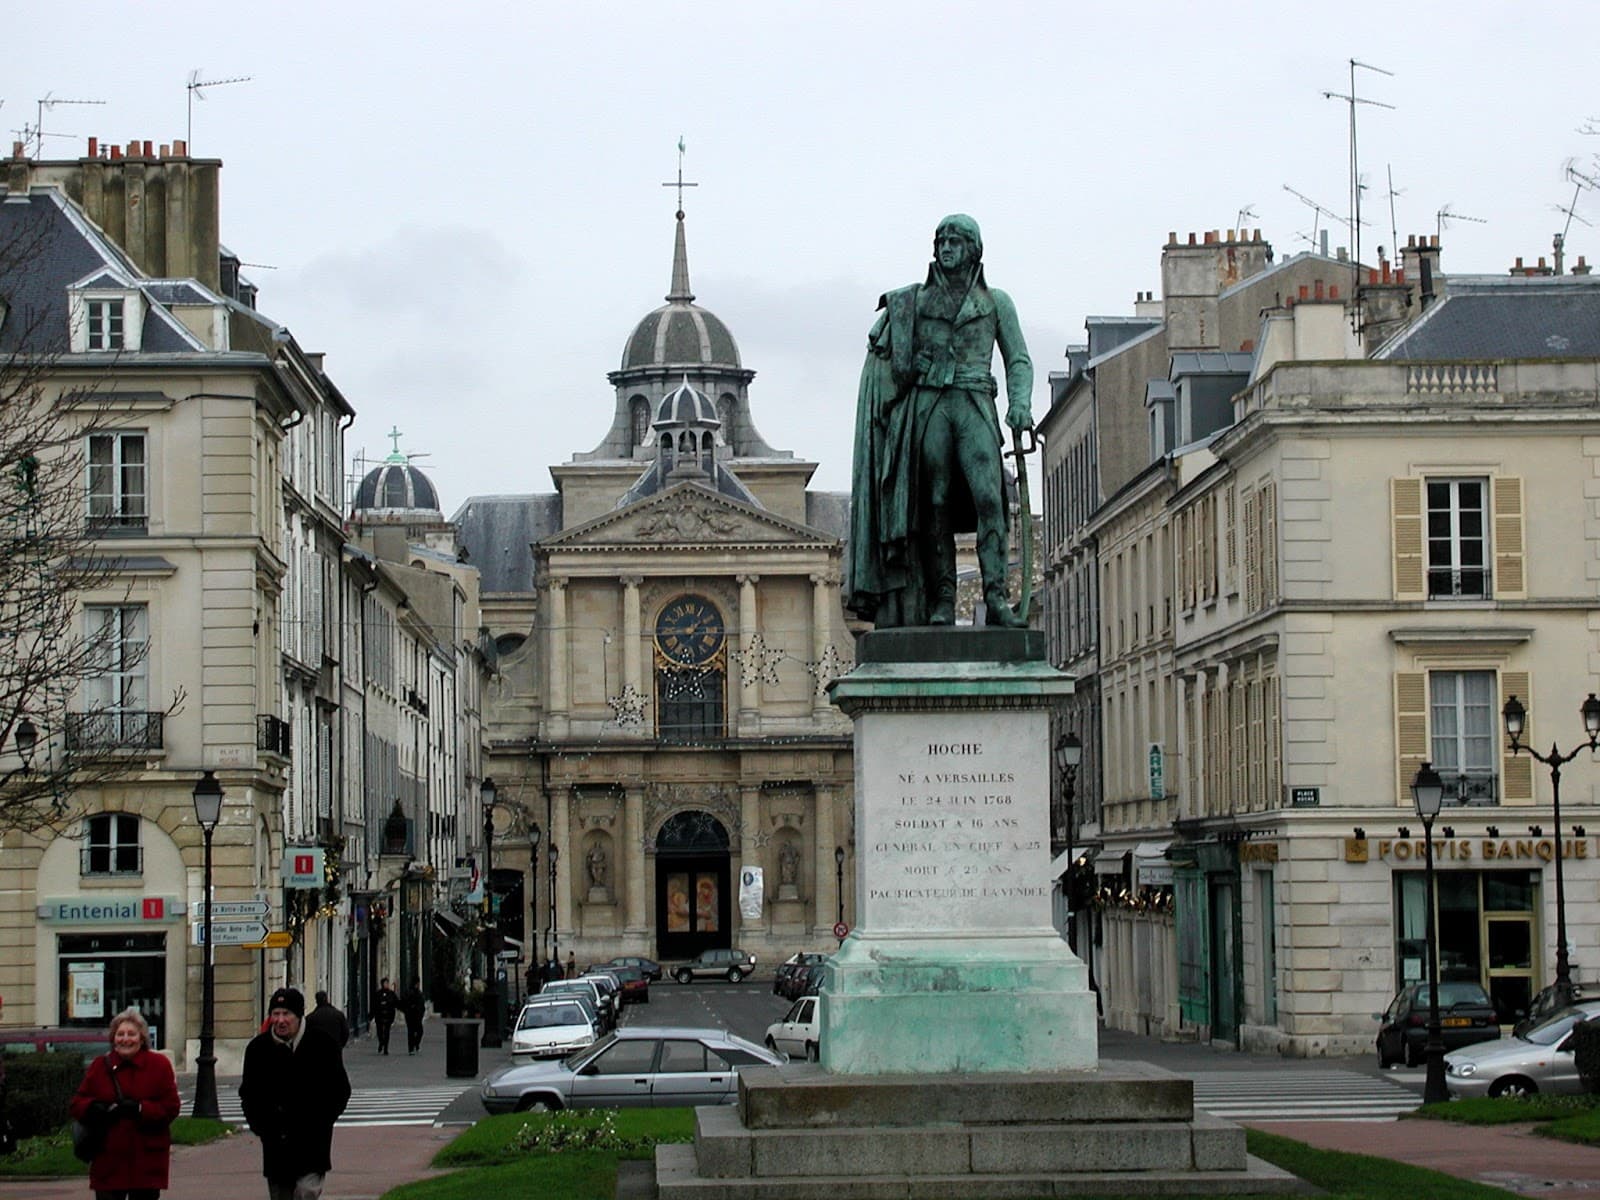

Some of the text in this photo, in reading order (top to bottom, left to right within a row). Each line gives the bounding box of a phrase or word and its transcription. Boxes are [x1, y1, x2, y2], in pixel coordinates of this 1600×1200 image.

[928, 743, 983, 755] HOCHE
[1150, 744, 1162, 799] ARMES
[936, 773, 1015, 784] VERSAILLES
[902, 796, 917, 806] LE
[984, 795, 1012, 805] 1768
[894, 819, 946, 829] SOLDAT
[971, 818, 984, 828] 16
[992, 818, 1018, 828] ANS
[1379, 839, 1472, 861] FORTIS
[1481, 839, 1588, 863] BANQUE
[904, 866, 938, 875] MORT
[870, 888, 958, 900] PACIFICATEUR
[59, 902, 137, 920] Entenial
